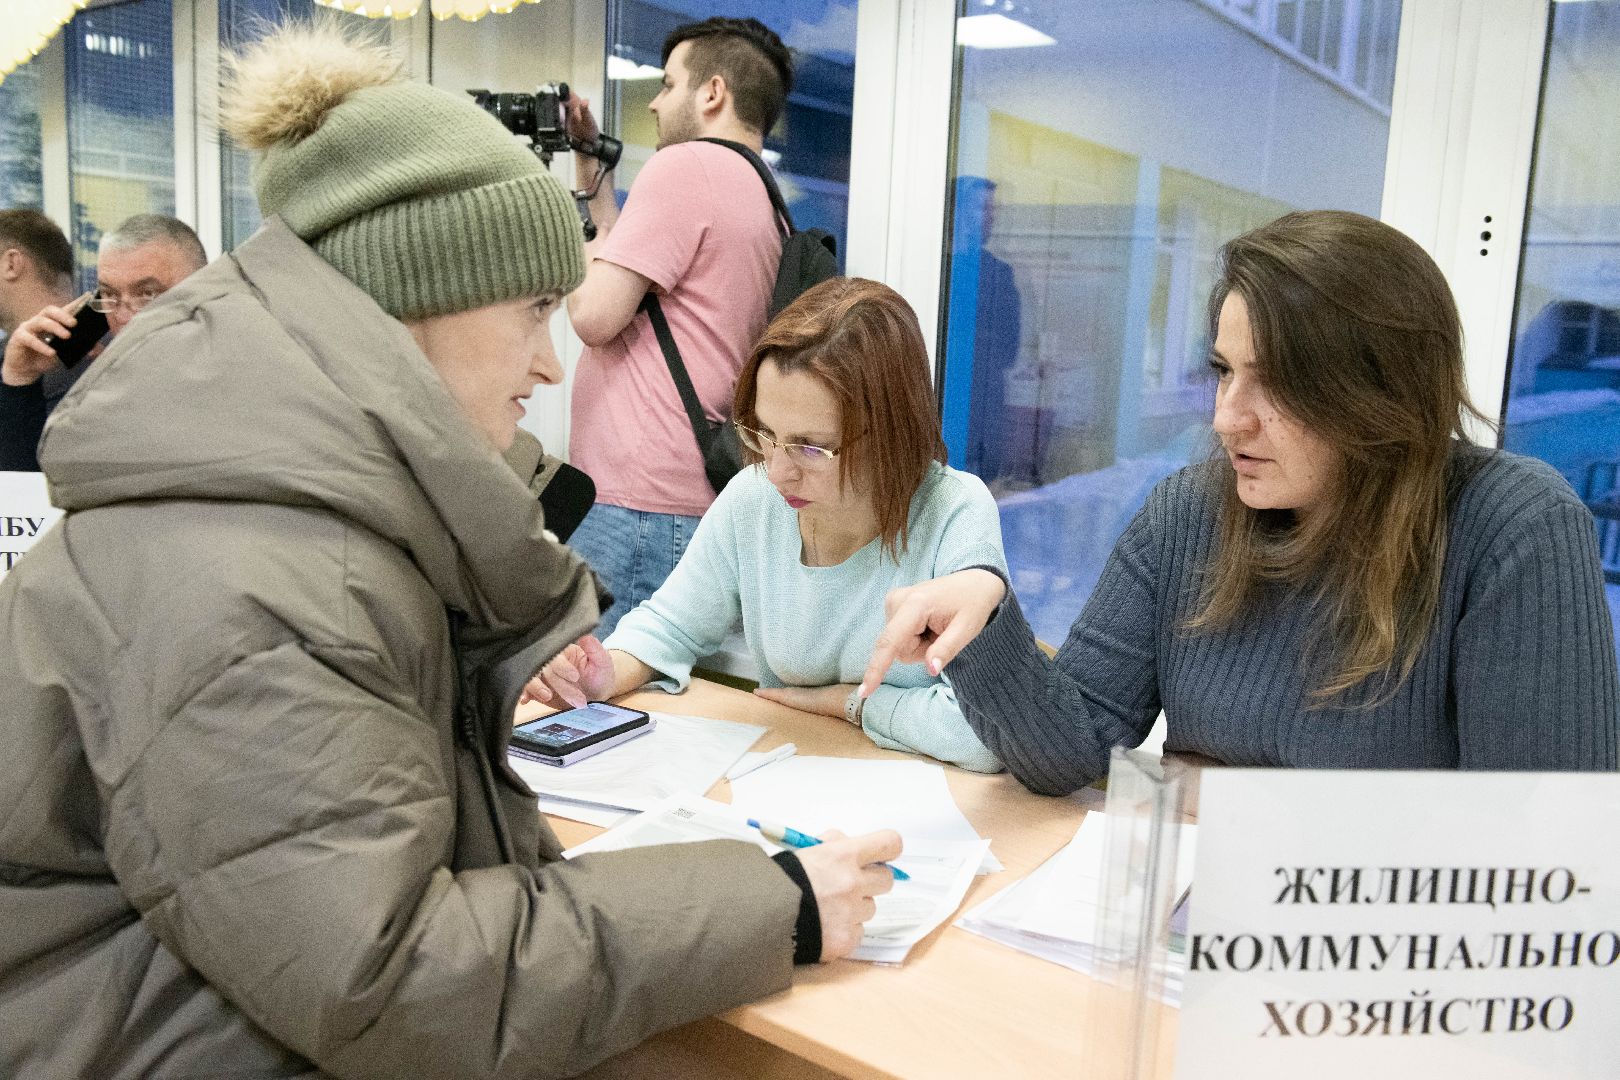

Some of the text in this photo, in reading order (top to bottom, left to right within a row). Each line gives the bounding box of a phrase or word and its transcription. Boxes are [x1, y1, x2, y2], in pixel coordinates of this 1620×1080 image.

[1273, 867, 1591, 911] ЖИЛИЩНО-
[1189, 930, 1620, 972] КОММУНАЛЬНО
[1260, 989, 1574, 1037] ХОЗЯЙСТВО
